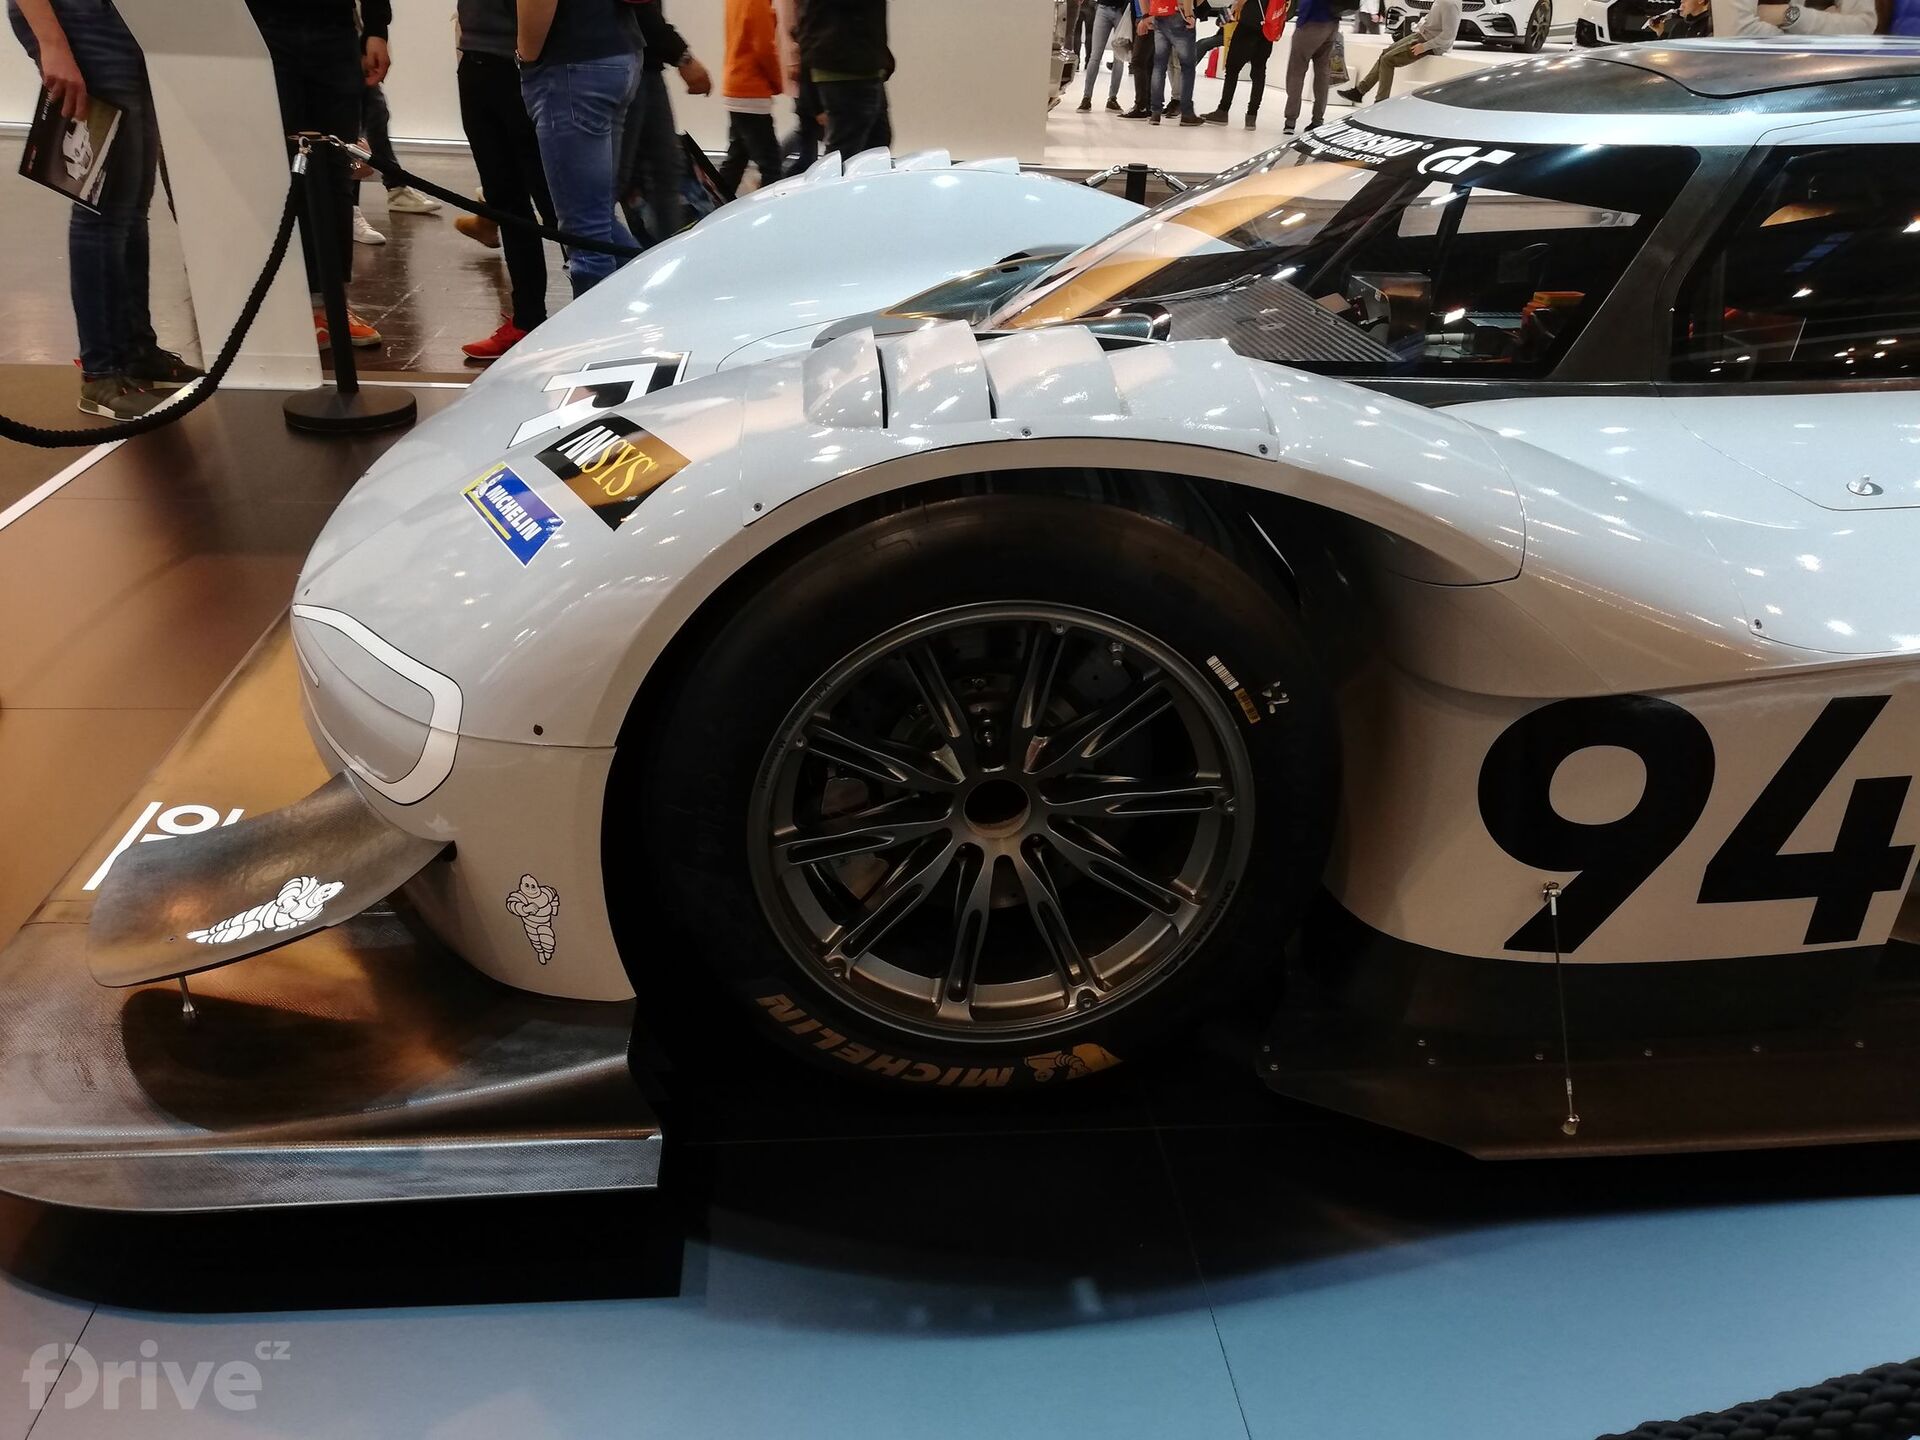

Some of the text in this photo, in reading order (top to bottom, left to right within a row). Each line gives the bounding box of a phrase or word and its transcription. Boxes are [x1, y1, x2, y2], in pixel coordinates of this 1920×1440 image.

[1326, 145, 1387, 165] SIMULATOR
[556, 425, 656, 497] ANSYS
[485, 484, 543, 542] MICHELIN
[1478, 692, 1916, 955] 94
[755, 993, 1015, 1088] MICHELIN
